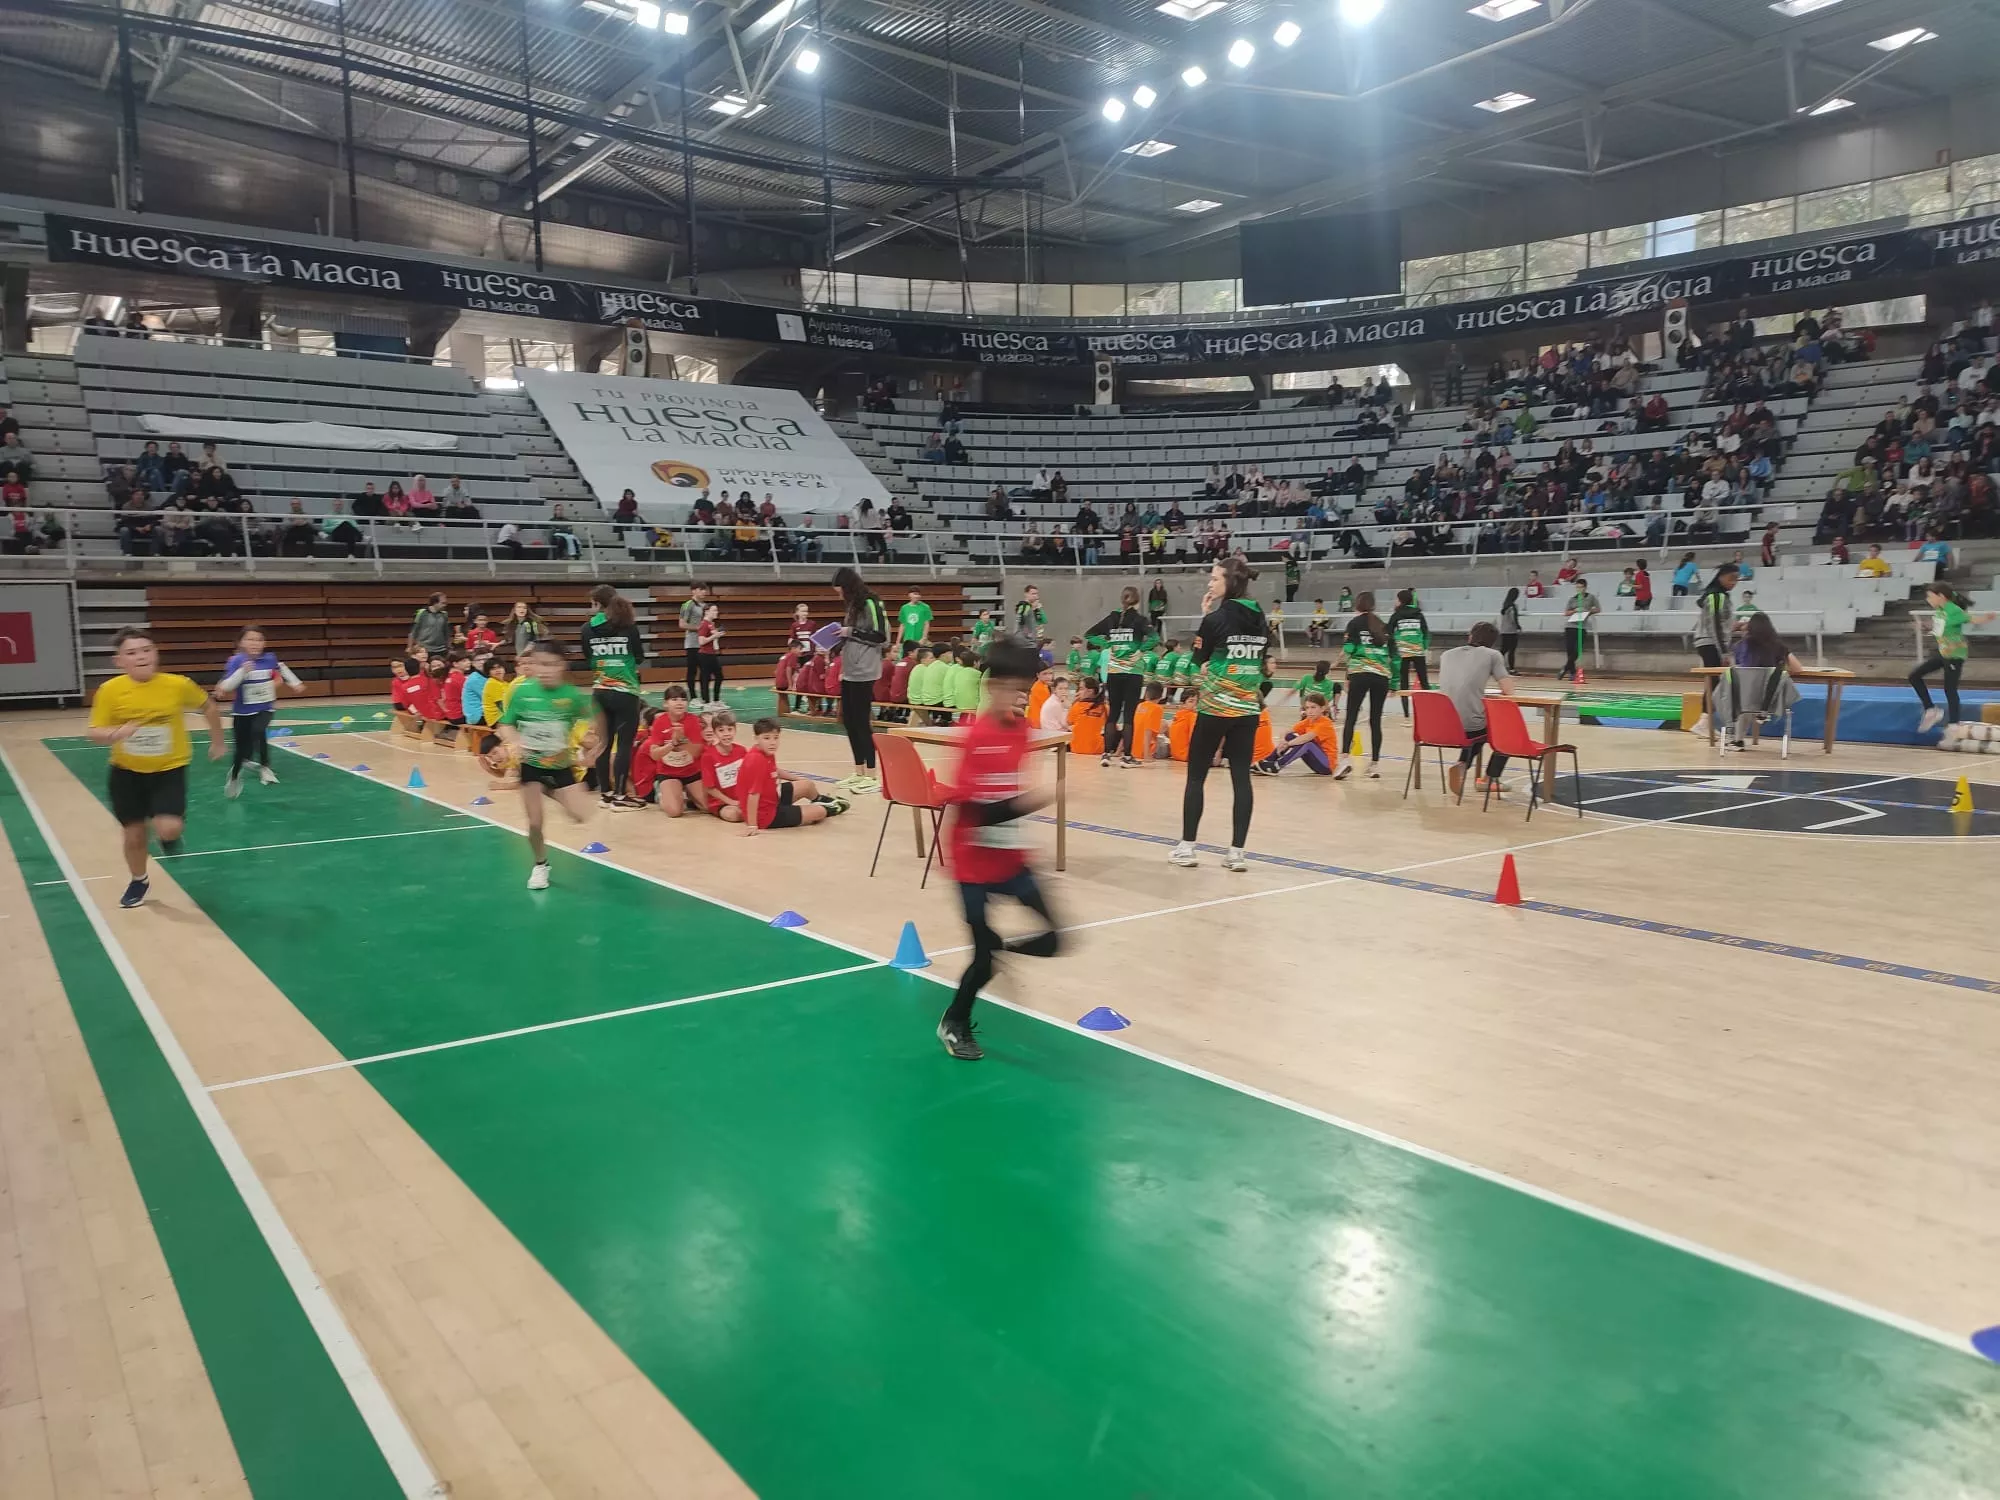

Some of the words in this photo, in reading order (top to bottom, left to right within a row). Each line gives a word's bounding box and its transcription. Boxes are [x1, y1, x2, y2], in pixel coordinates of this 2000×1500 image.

[69, 229, 232, 271] Huesca
[1749, 242, 1877, 279] Huesca
[440, 270, 557, 302] Huesca
[807, 317, 892, 338] Ayuntamiento
[1455, 299, 1567, 330] Huesca
[810, 332, 825, 345] de
[828, 334, 874, 351] Huesca
[961, 332, 1049, 351] Huesca
[1203, 332, 1304, 354] Huesca
[568, 401, 809, 438] Huesca
[722, 477, 828, 489] HUESCA
